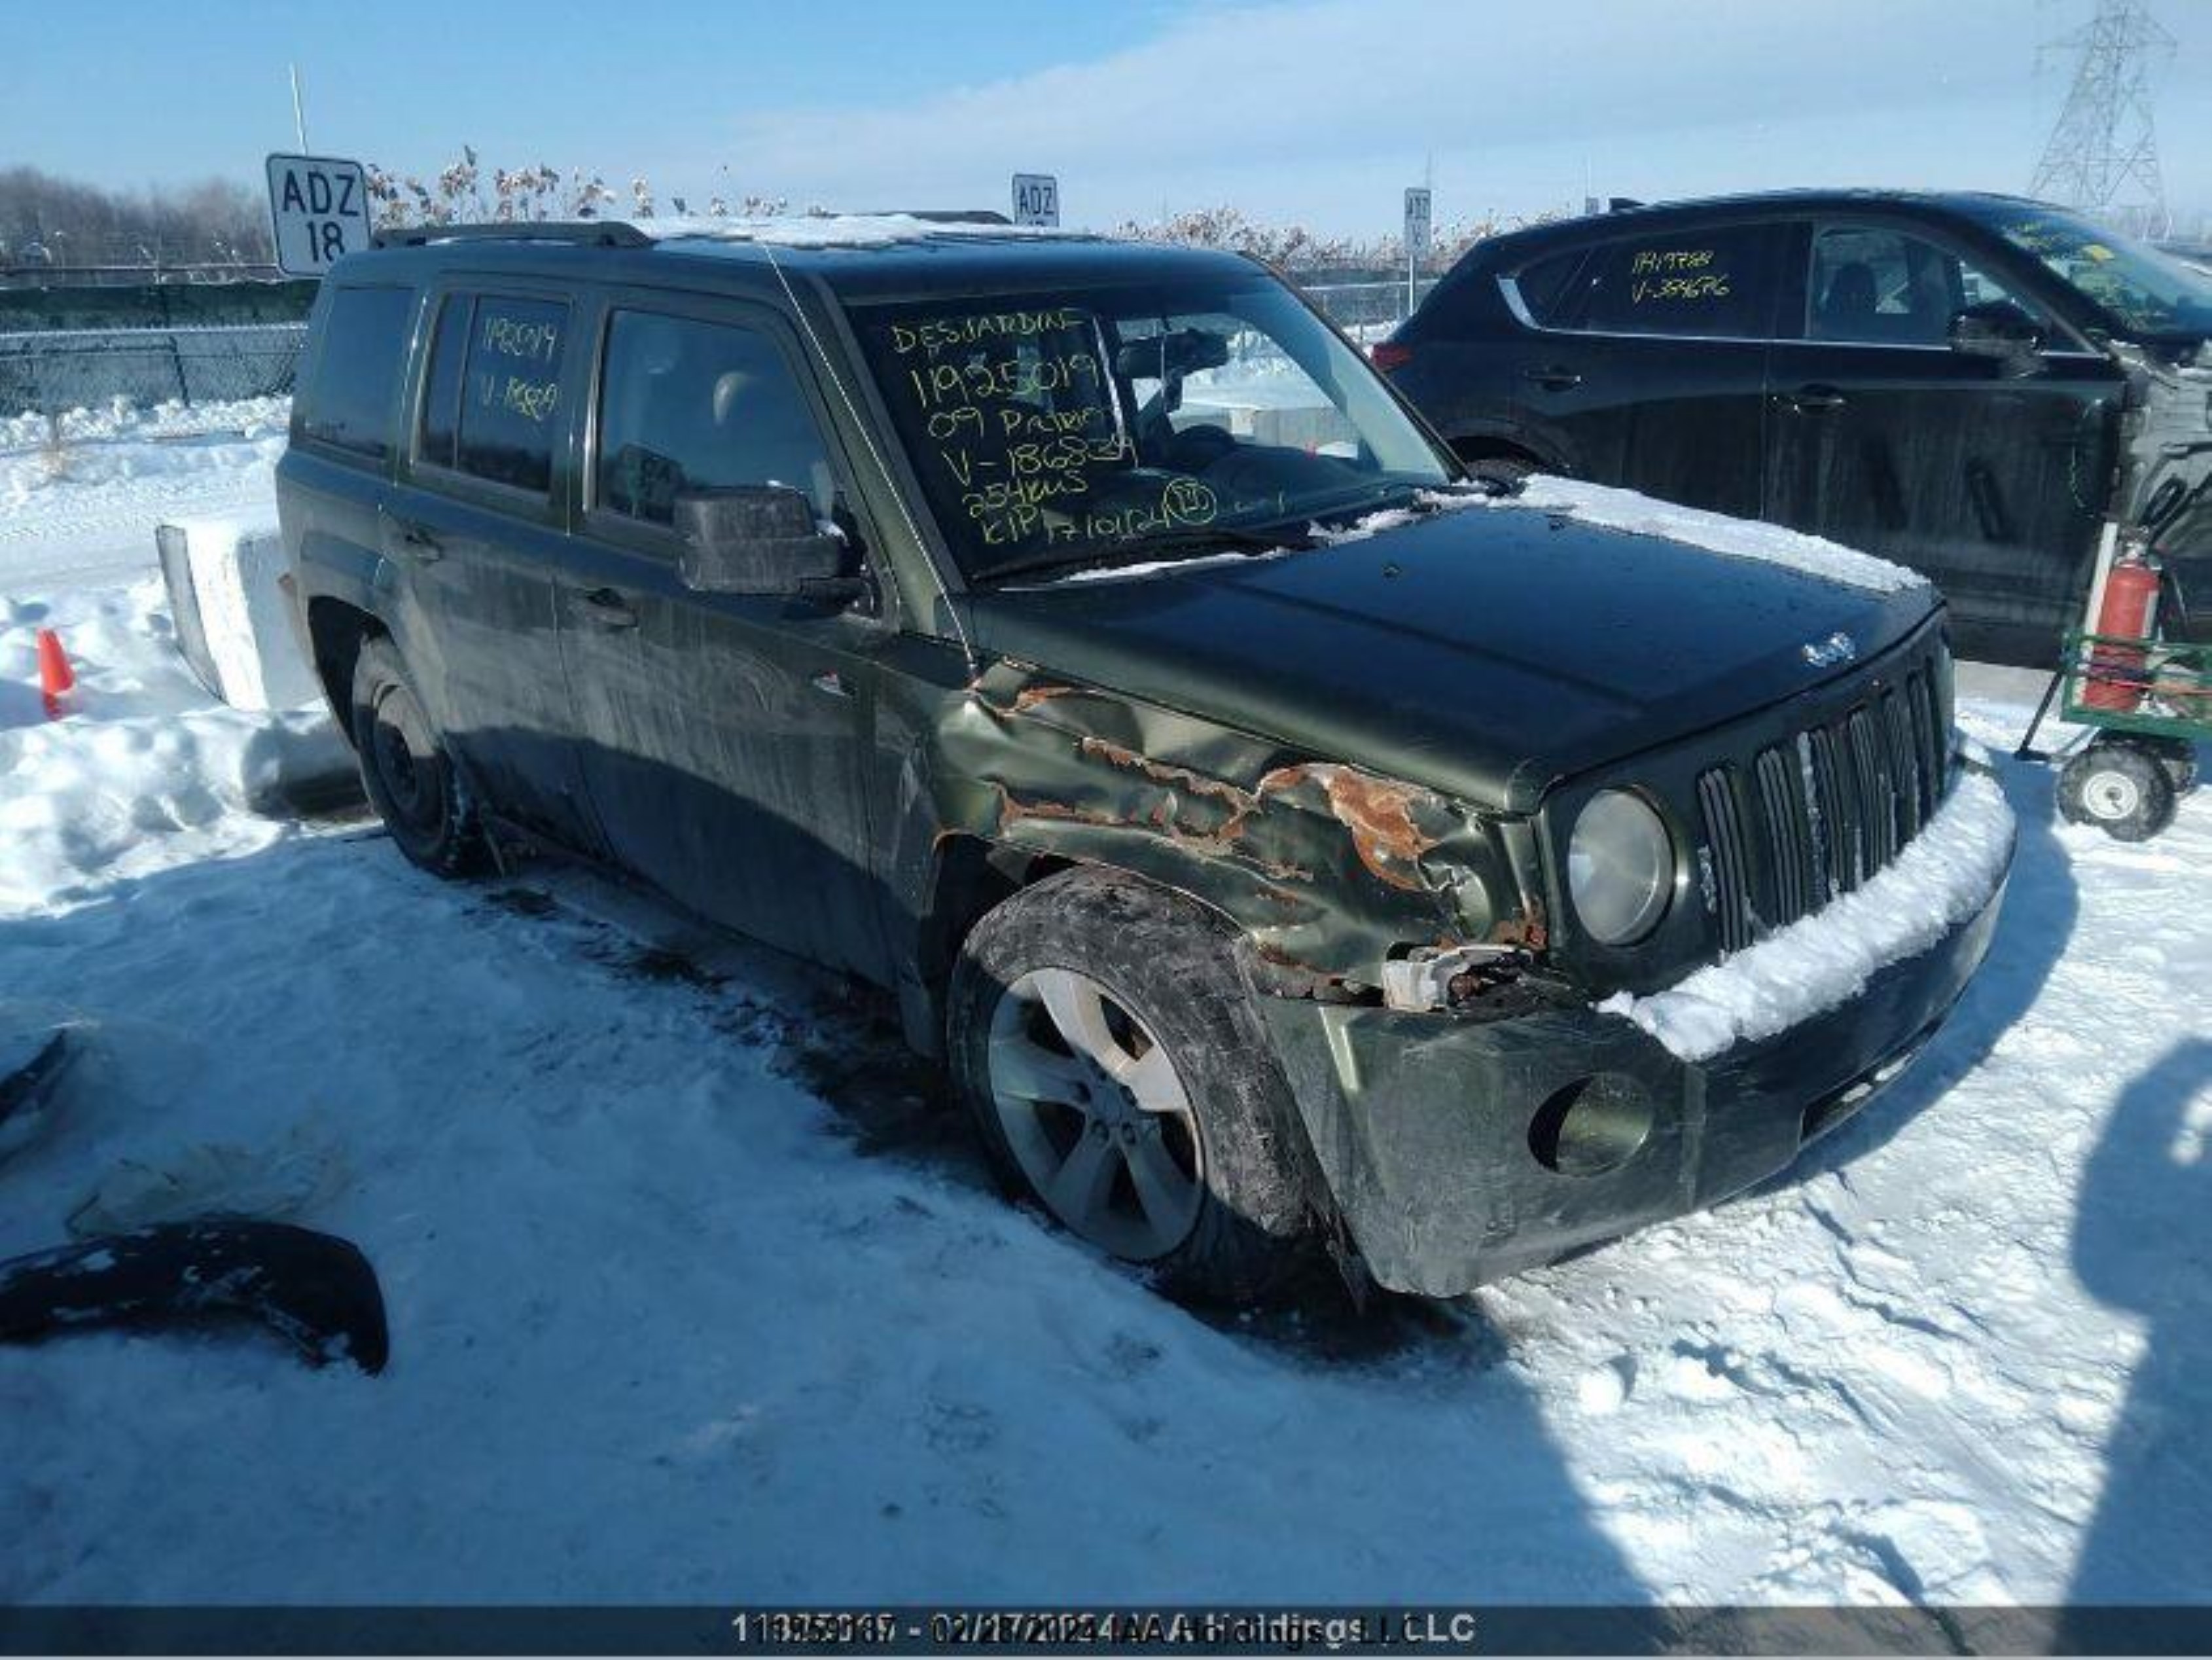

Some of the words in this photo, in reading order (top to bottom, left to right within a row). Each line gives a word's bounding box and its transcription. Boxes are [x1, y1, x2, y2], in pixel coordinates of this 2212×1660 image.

[283, 169, 359, 217] ADZ
[1019, 185, 1055, 215] ADZ
[306, 220, 346, 262] 18
[927, 406, 984, 440] 09
